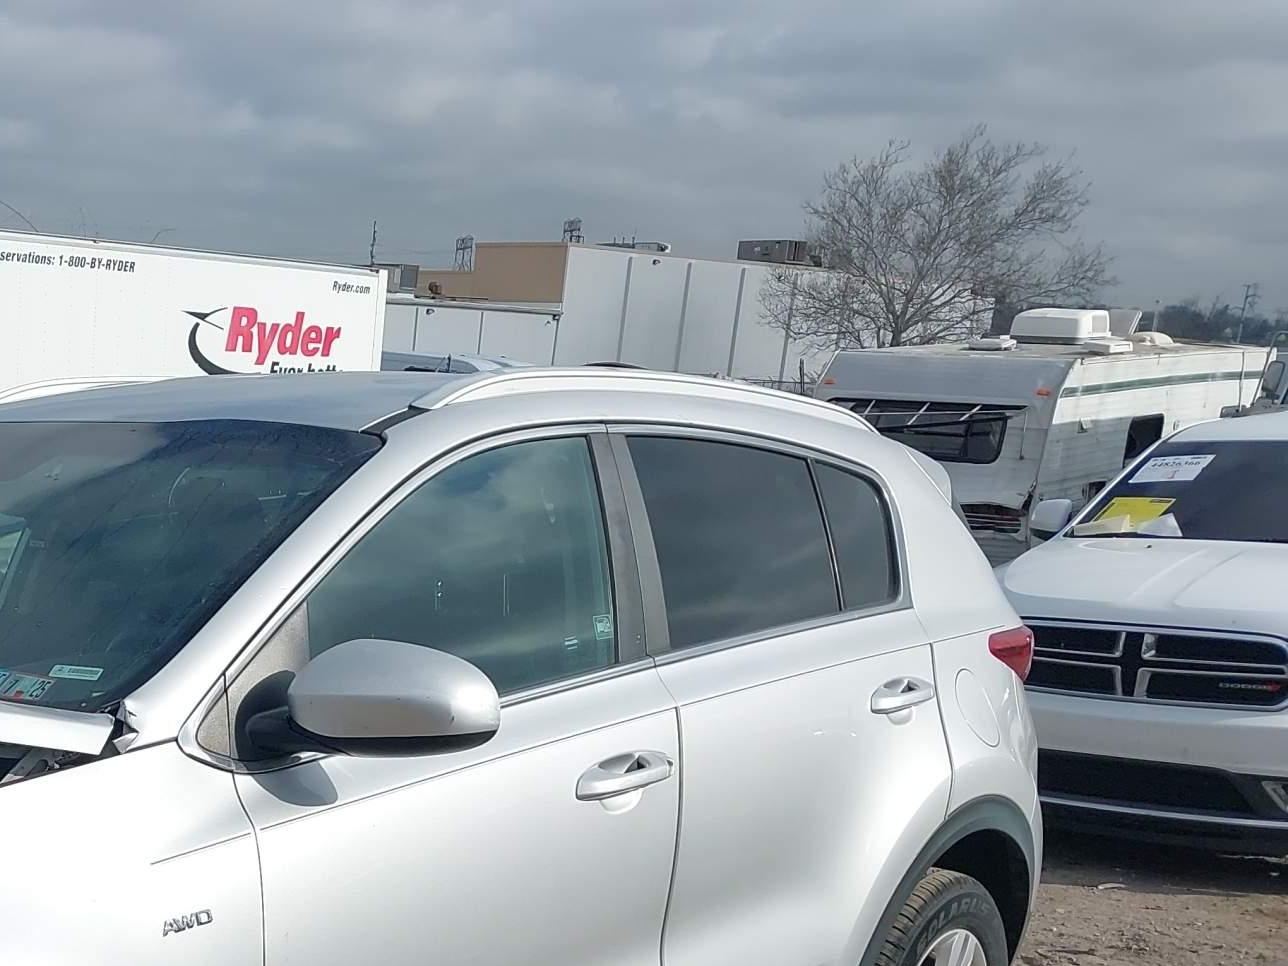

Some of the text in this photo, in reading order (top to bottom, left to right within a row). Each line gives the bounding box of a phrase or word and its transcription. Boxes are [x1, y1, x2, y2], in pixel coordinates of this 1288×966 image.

[58, 254, 136, 273] 1-800-BY-RYDER
[332, 280, 372, 294] Ryder.com
[225, 306, 342, 366] Ryder
[1218, 682, 1272, 690] DODGE
[163, 909, 213, 936] AWD
